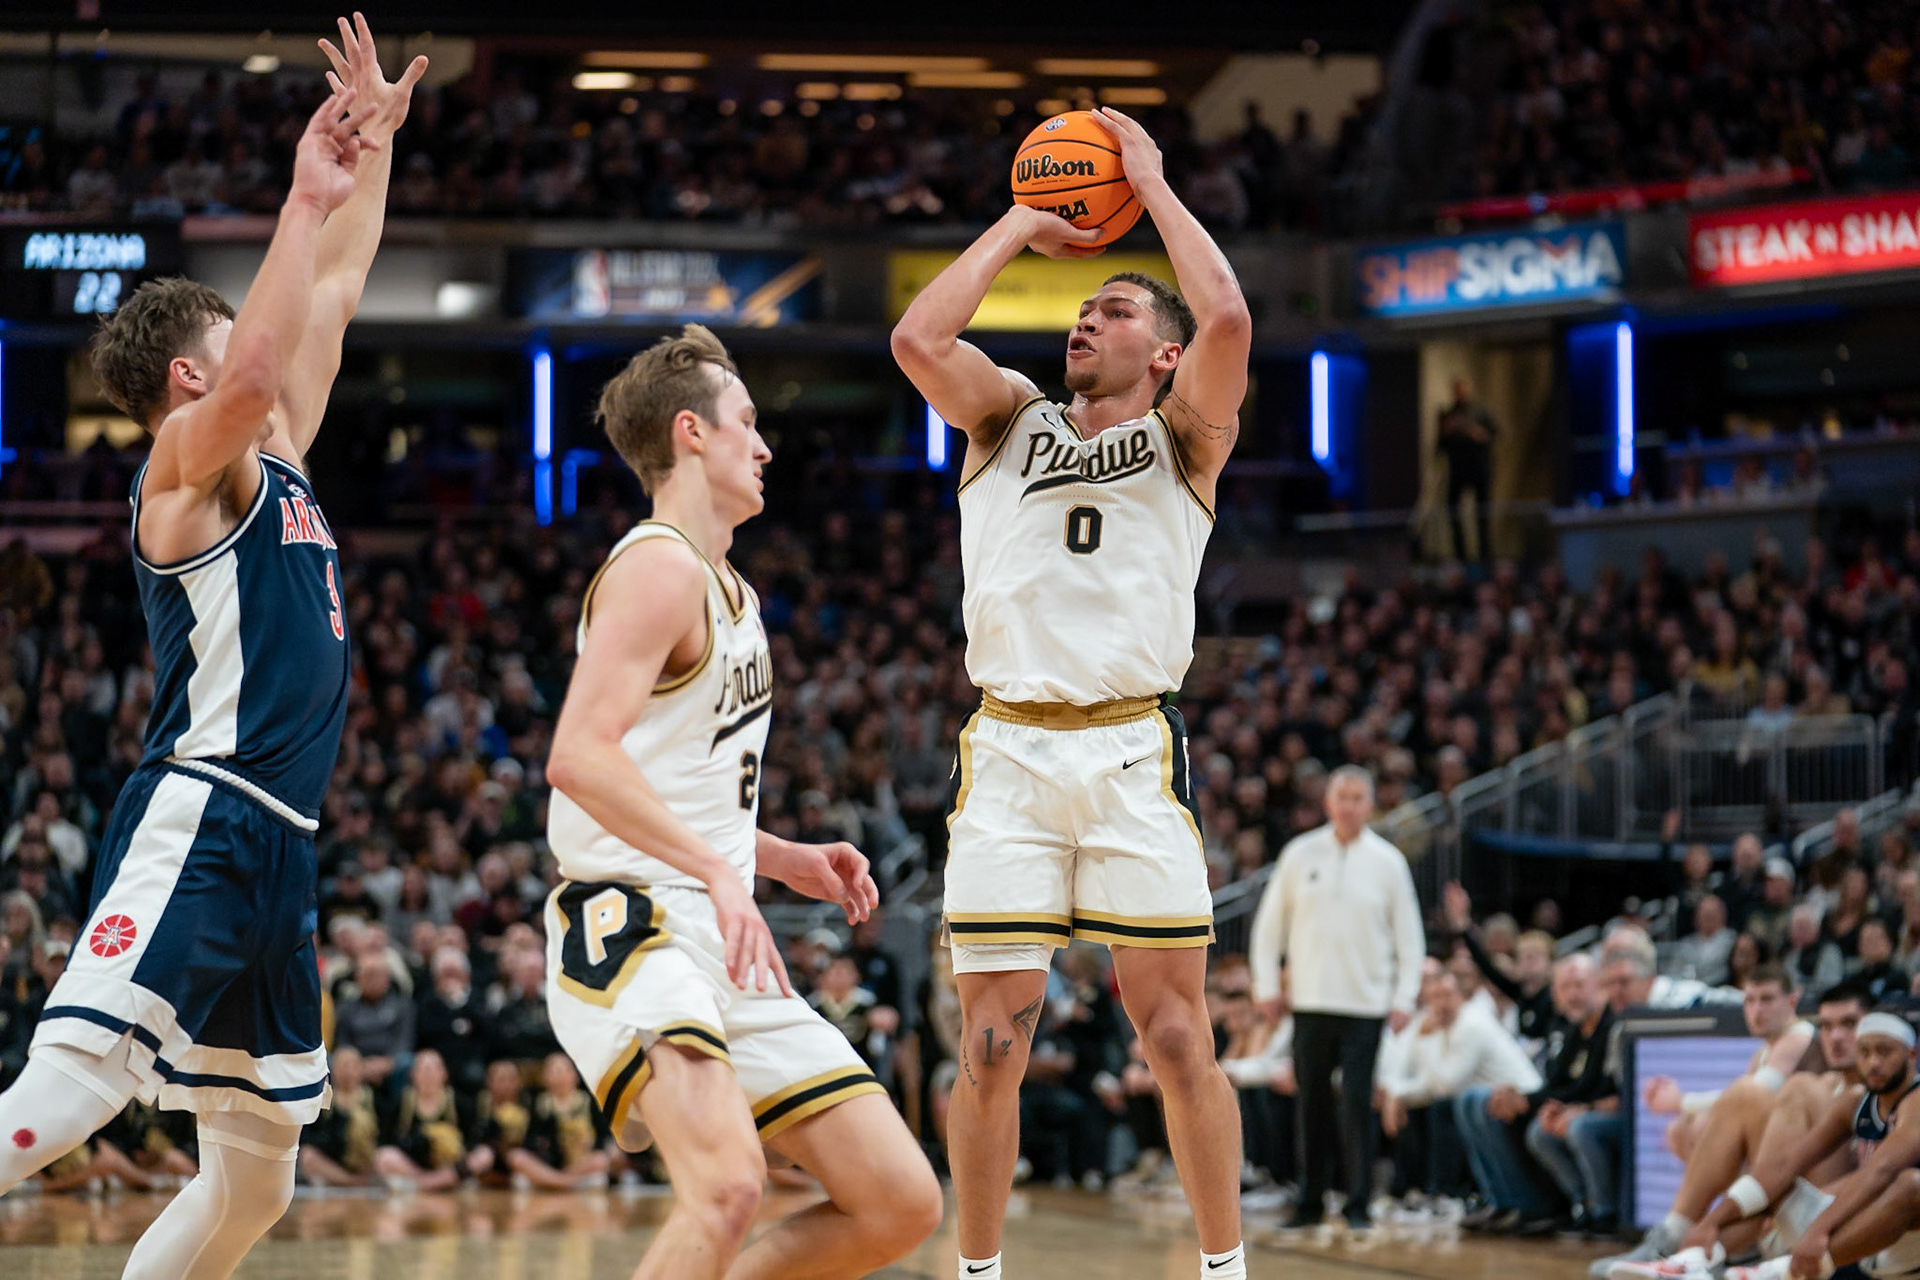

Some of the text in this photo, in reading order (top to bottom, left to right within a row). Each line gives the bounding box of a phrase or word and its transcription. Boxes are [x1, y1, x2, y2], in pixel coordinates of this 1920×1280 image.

[1016, 154, 1096, 184] Wilson
[24, 232, 146, 269] ARIZONA
[1694, 224, 1813, 271] STEAK
[1841, 207, 1920, 257] SHA
[1020, 429, 1157, 485] Purdue
[1063, 503, 1104, 555] 0
[738, 750, 758, 811] 2
[582, 886, 628, 967] P
